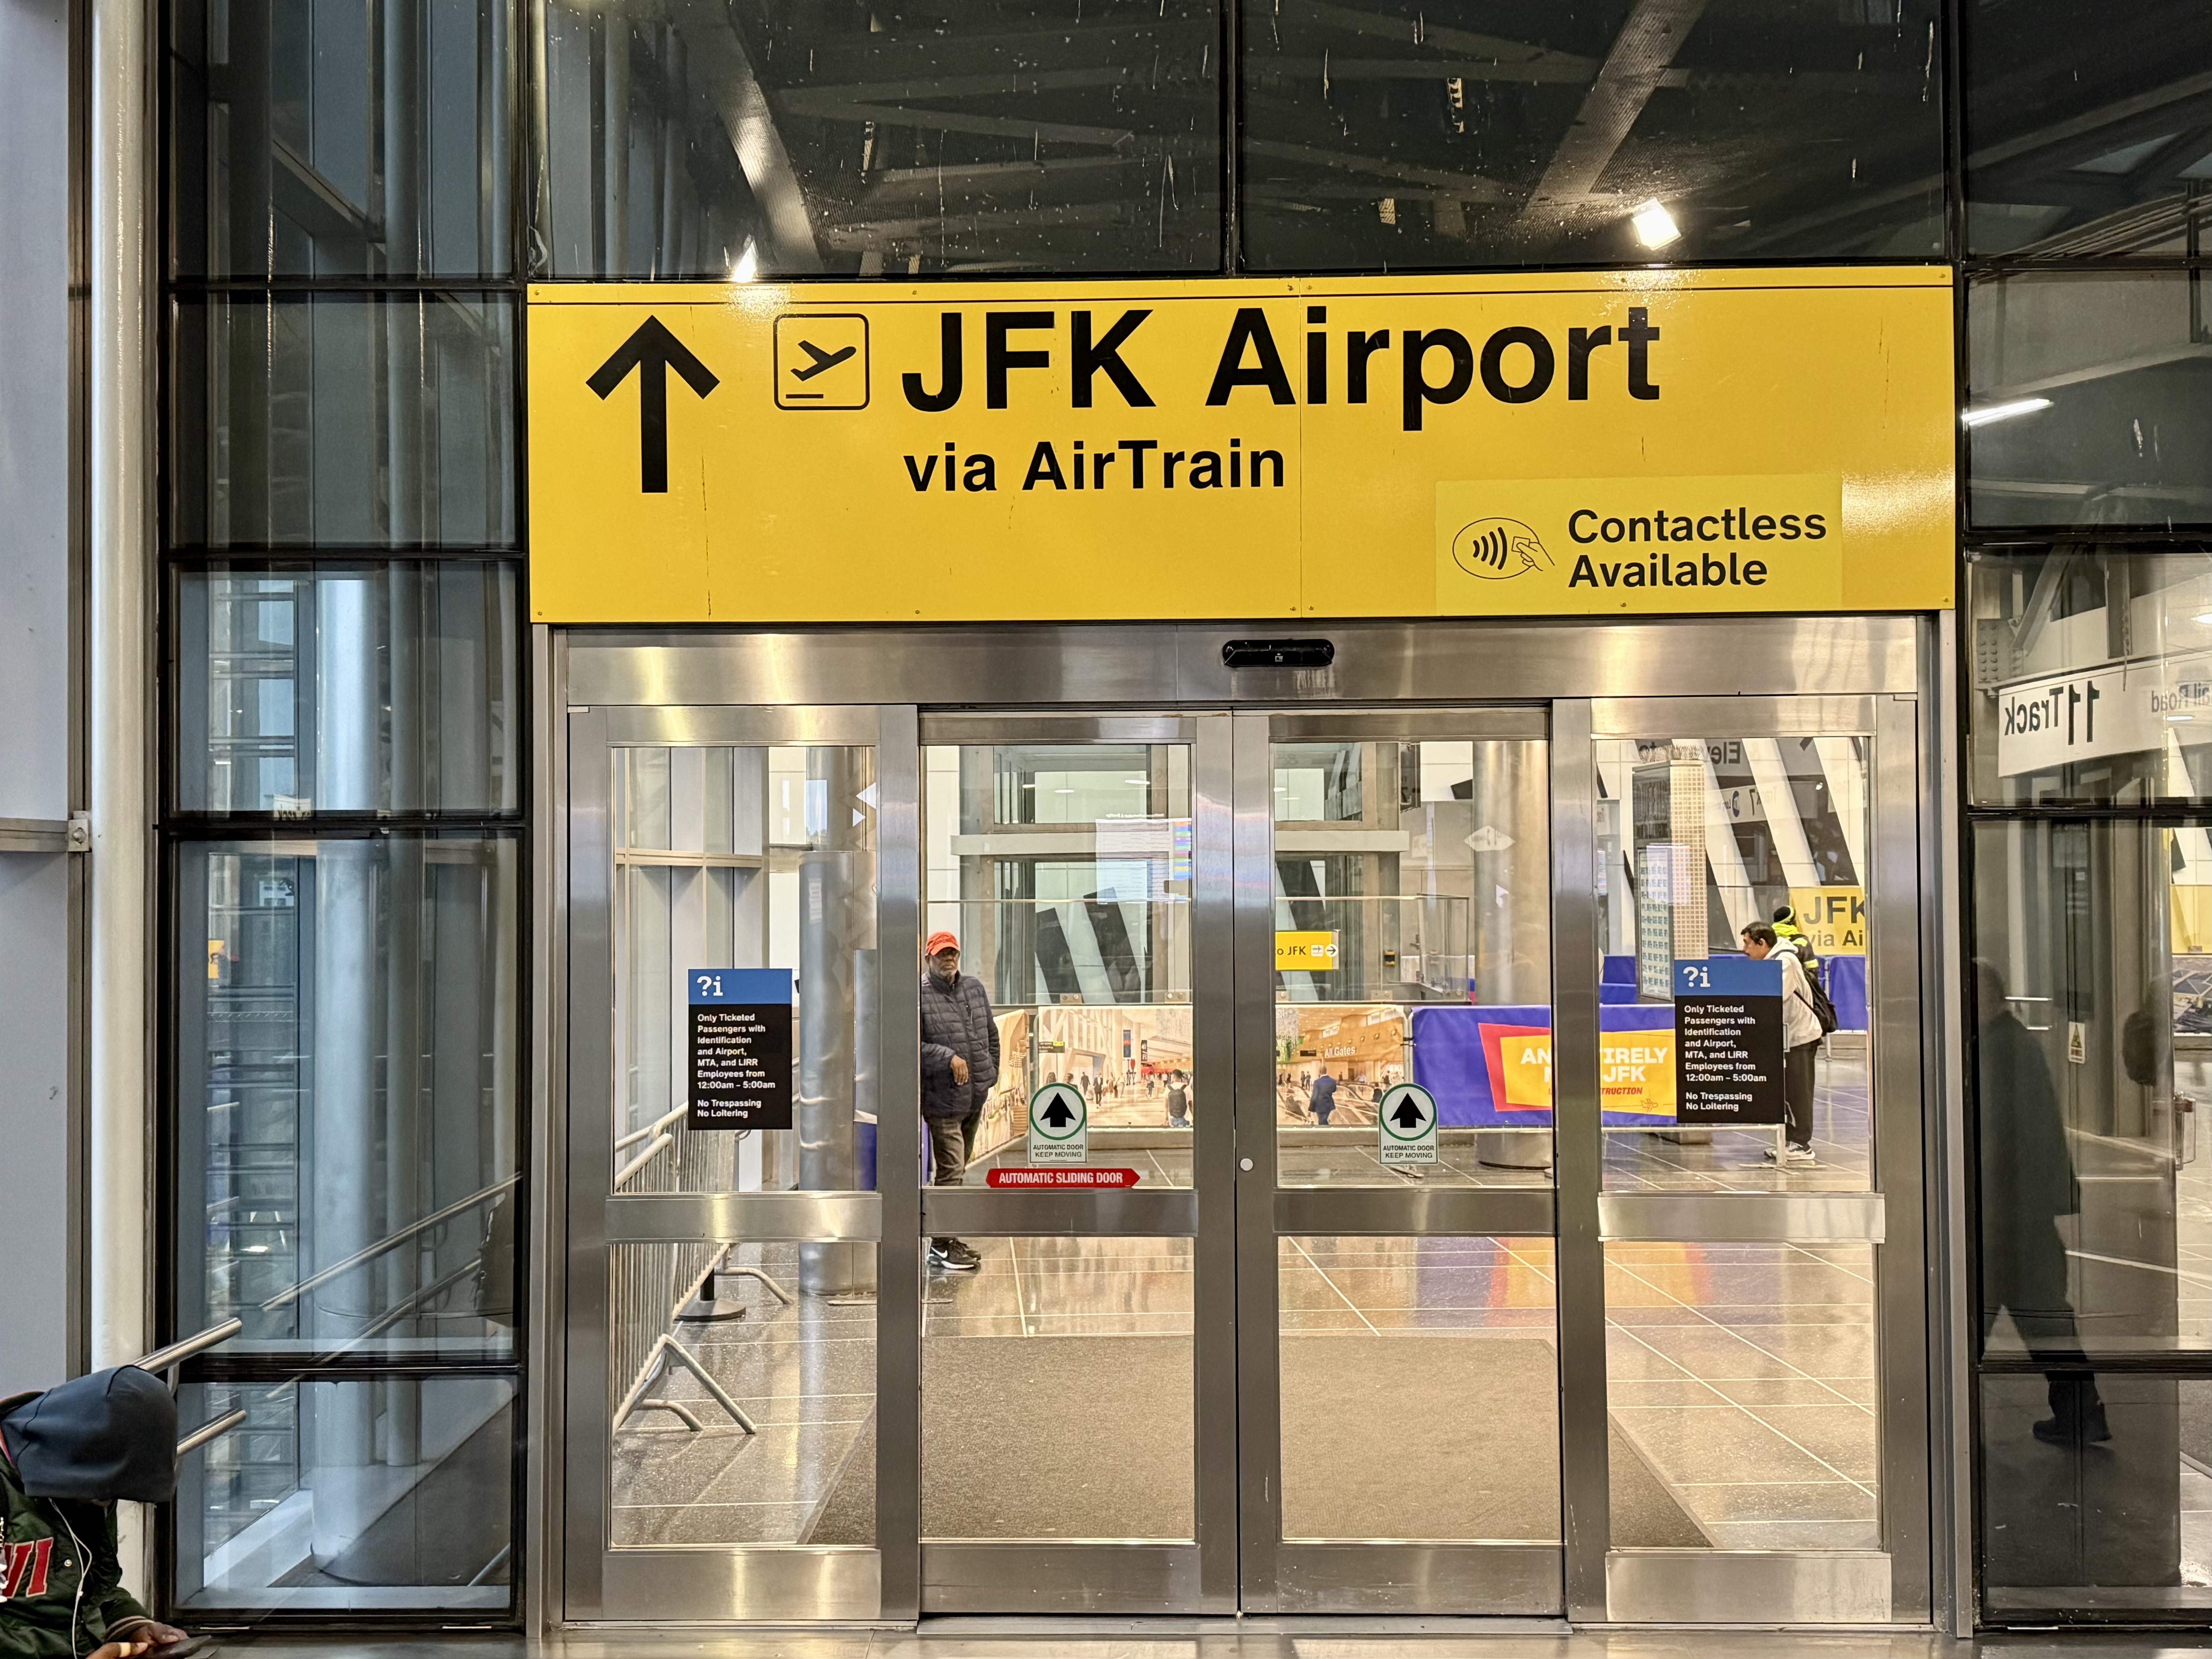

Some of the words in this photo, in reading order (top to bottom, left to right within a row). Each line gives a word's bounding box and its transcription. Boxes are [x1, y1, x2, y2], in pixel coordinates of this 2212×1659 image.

[902, 309, 1157, 412] JFK
[1205, 306, 1660, 431] Airport
[903, 442, 997, 492] via
[1022, 438, 1284, 490] AirTrain
[1569, 507, 1826, 544] Contactless
[1568, 552, 1767, 588] Available
[1803, 896, 1865, 925] JFK
[1809, 930, 1835, 947] via
[1287, 946, 1306, 956] JFK
[1684, 1005, 1705, 1014] Only
[697, 1014, 717, 1023] Only
[1684, 1016, 1735, 1026] Passengers
[697, 1025, 746, 1034] Passengers
[1685, 1028, 1741, 1036] Identification
[1703, 1039, 1736, 1049] Airport,
[715, 1047, 747, 1057] Airport,
[1324, 1048, 1333, 1058] All
[1334, 1045, 1356, 1056] Gates
[1520, 1048, 1552, 1064] AN
[1600, 1047, 1668, 1064] IRELY
[1685, 1051, 1707, 1060] MTA,
[697, 1059, 719, 1068] MTA,
[1685, 1062, 1734, 1072] Employees
[697, 1070, 744, 1079] Employees
[1603, 1066, 1646, 1082] JFK
[1732, 1073, 1767, 1082] 5:00am
[1700, 1092, 1752, 1102] Trespassing
[711, 1099, 761, 1108] Trespassing
[1700, 1102, 1739, 1112] Loitering
[711, 1109, 748, 1119] Loitering
[999, 1172, 1054, 1183] AUTOMATIC
[1056, 1172, 1093, 1183] SLIDING
[1096, 1172, 1123, 1183] DOOR
